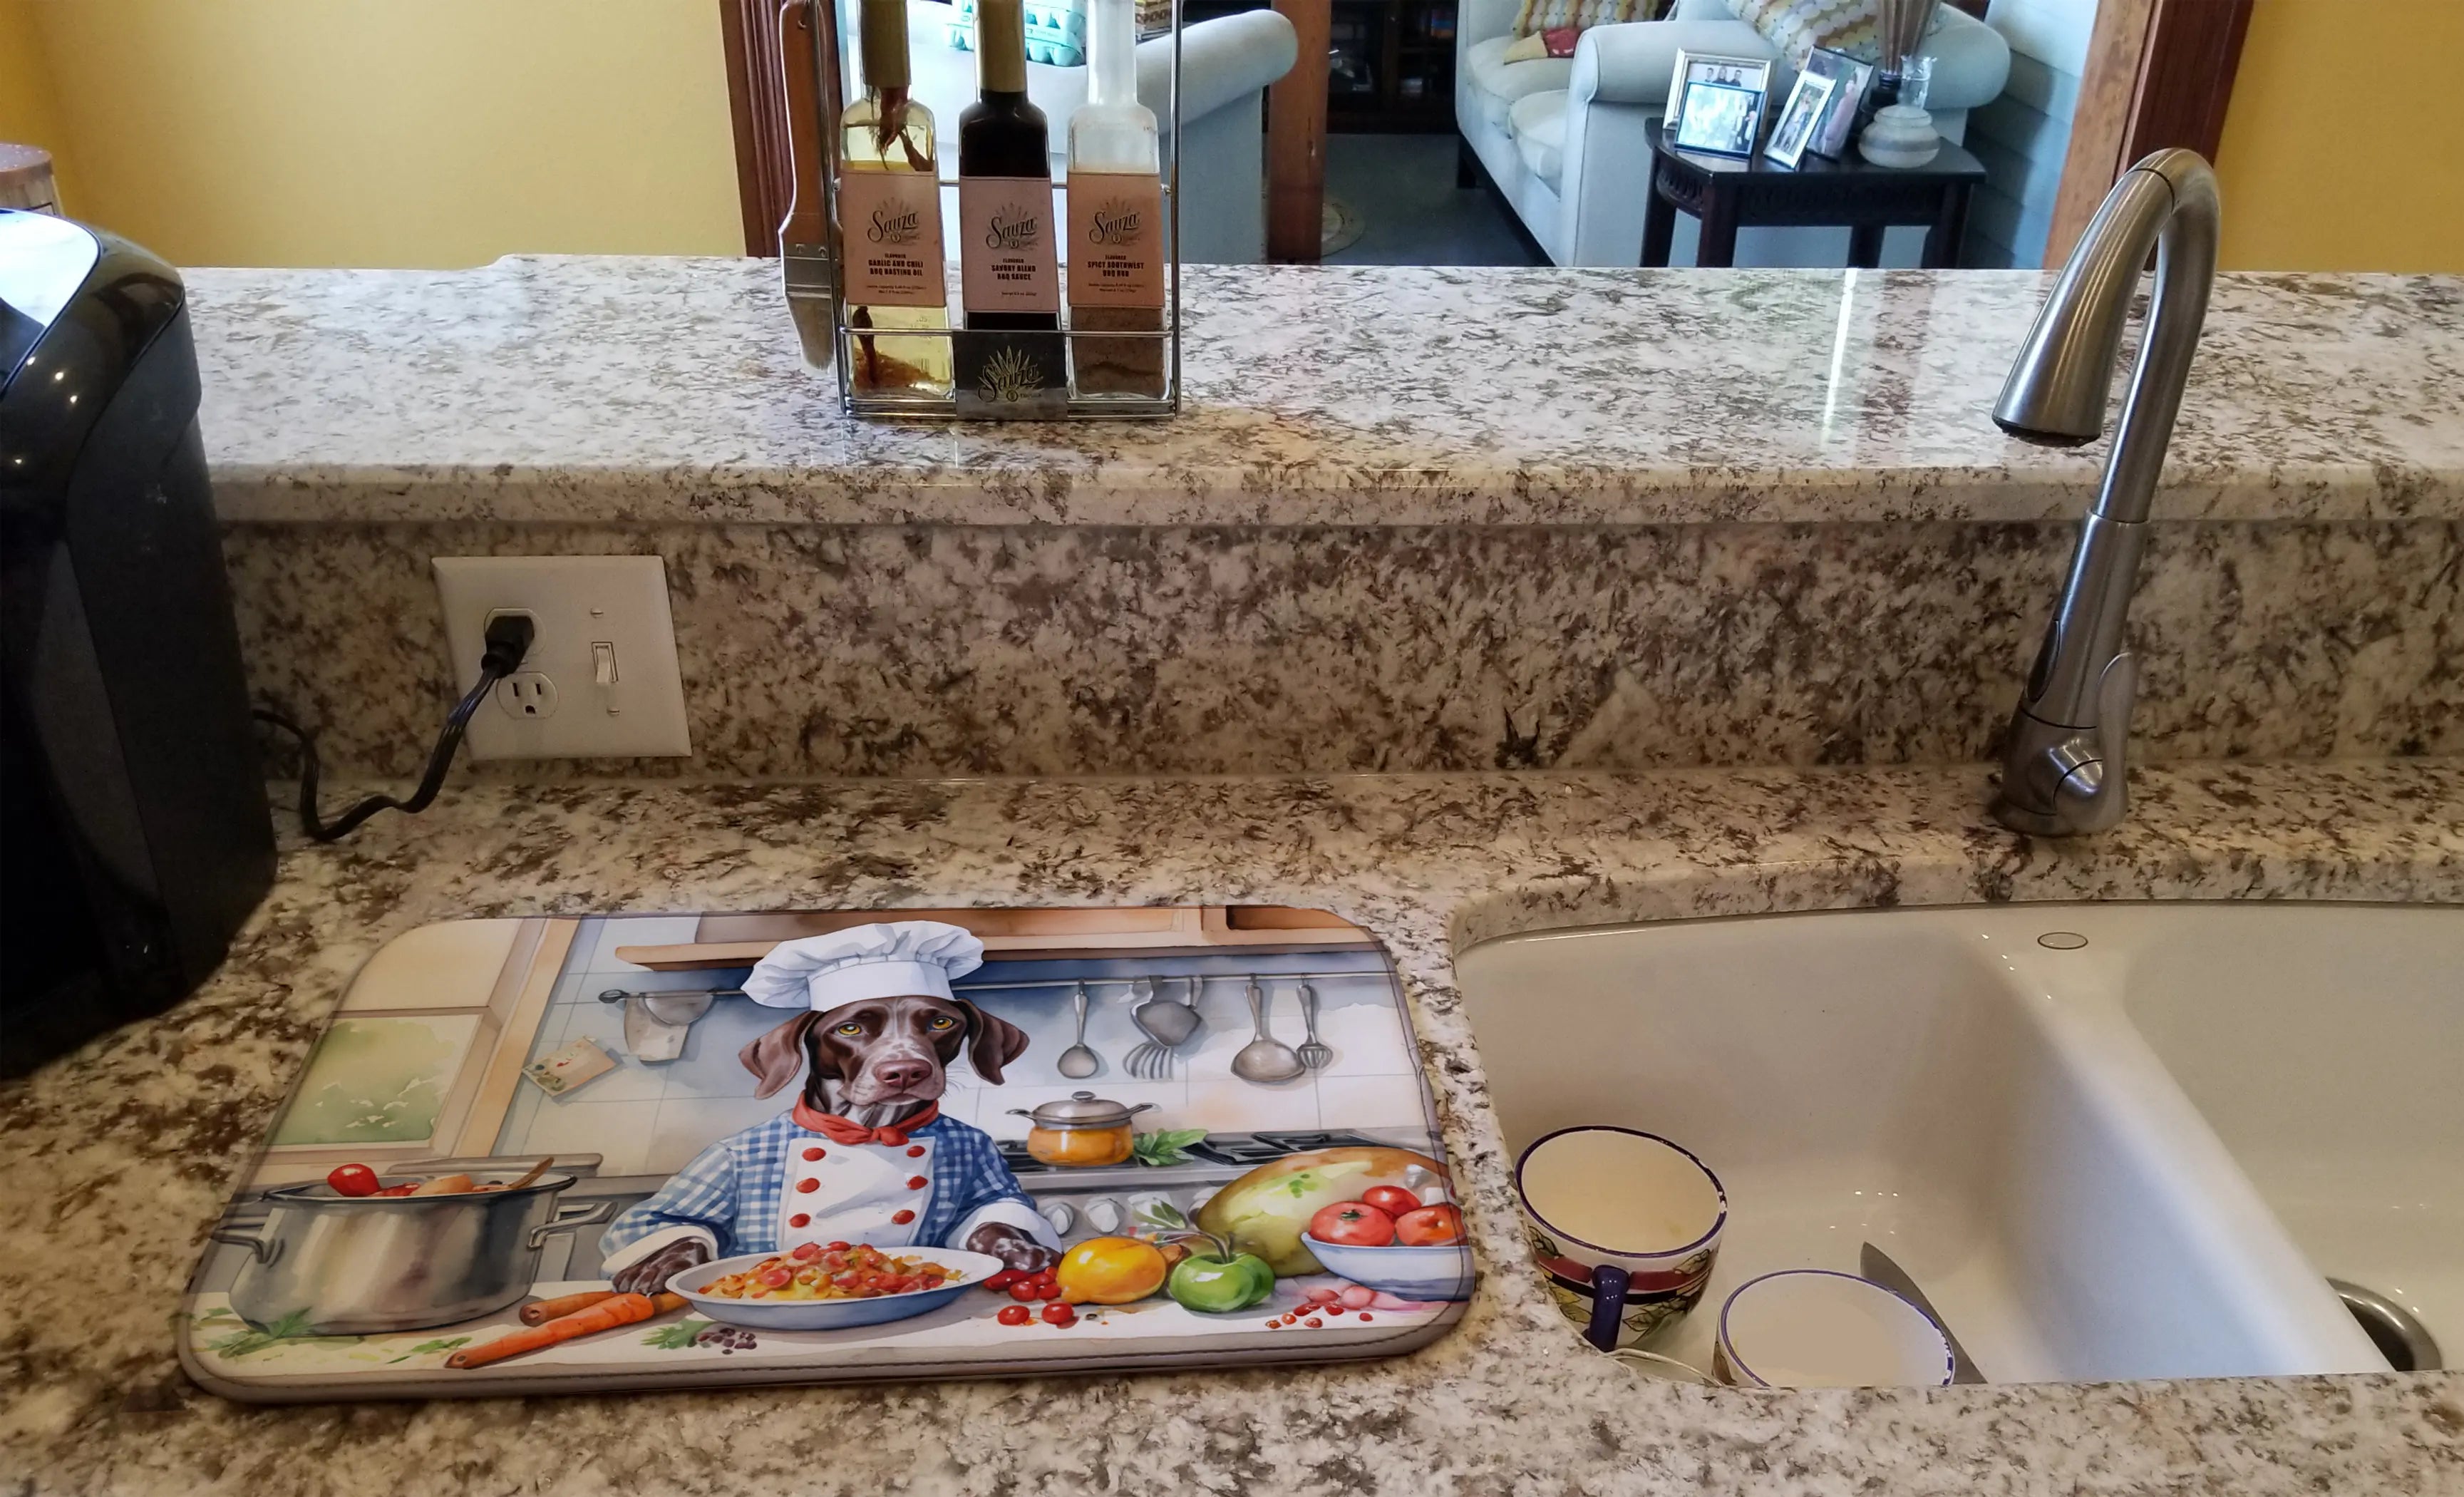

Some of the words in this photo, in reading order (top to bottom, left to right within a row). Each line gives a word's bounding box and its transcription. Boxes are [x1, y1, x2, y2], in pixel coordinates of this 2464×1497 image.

[867, 210, 918, 242] Sauza
[986, 217, 1038, 249] Sauza
[1089, 211, 1140, 244] Sauza
[977, 364, 1041, 403] Sauza
